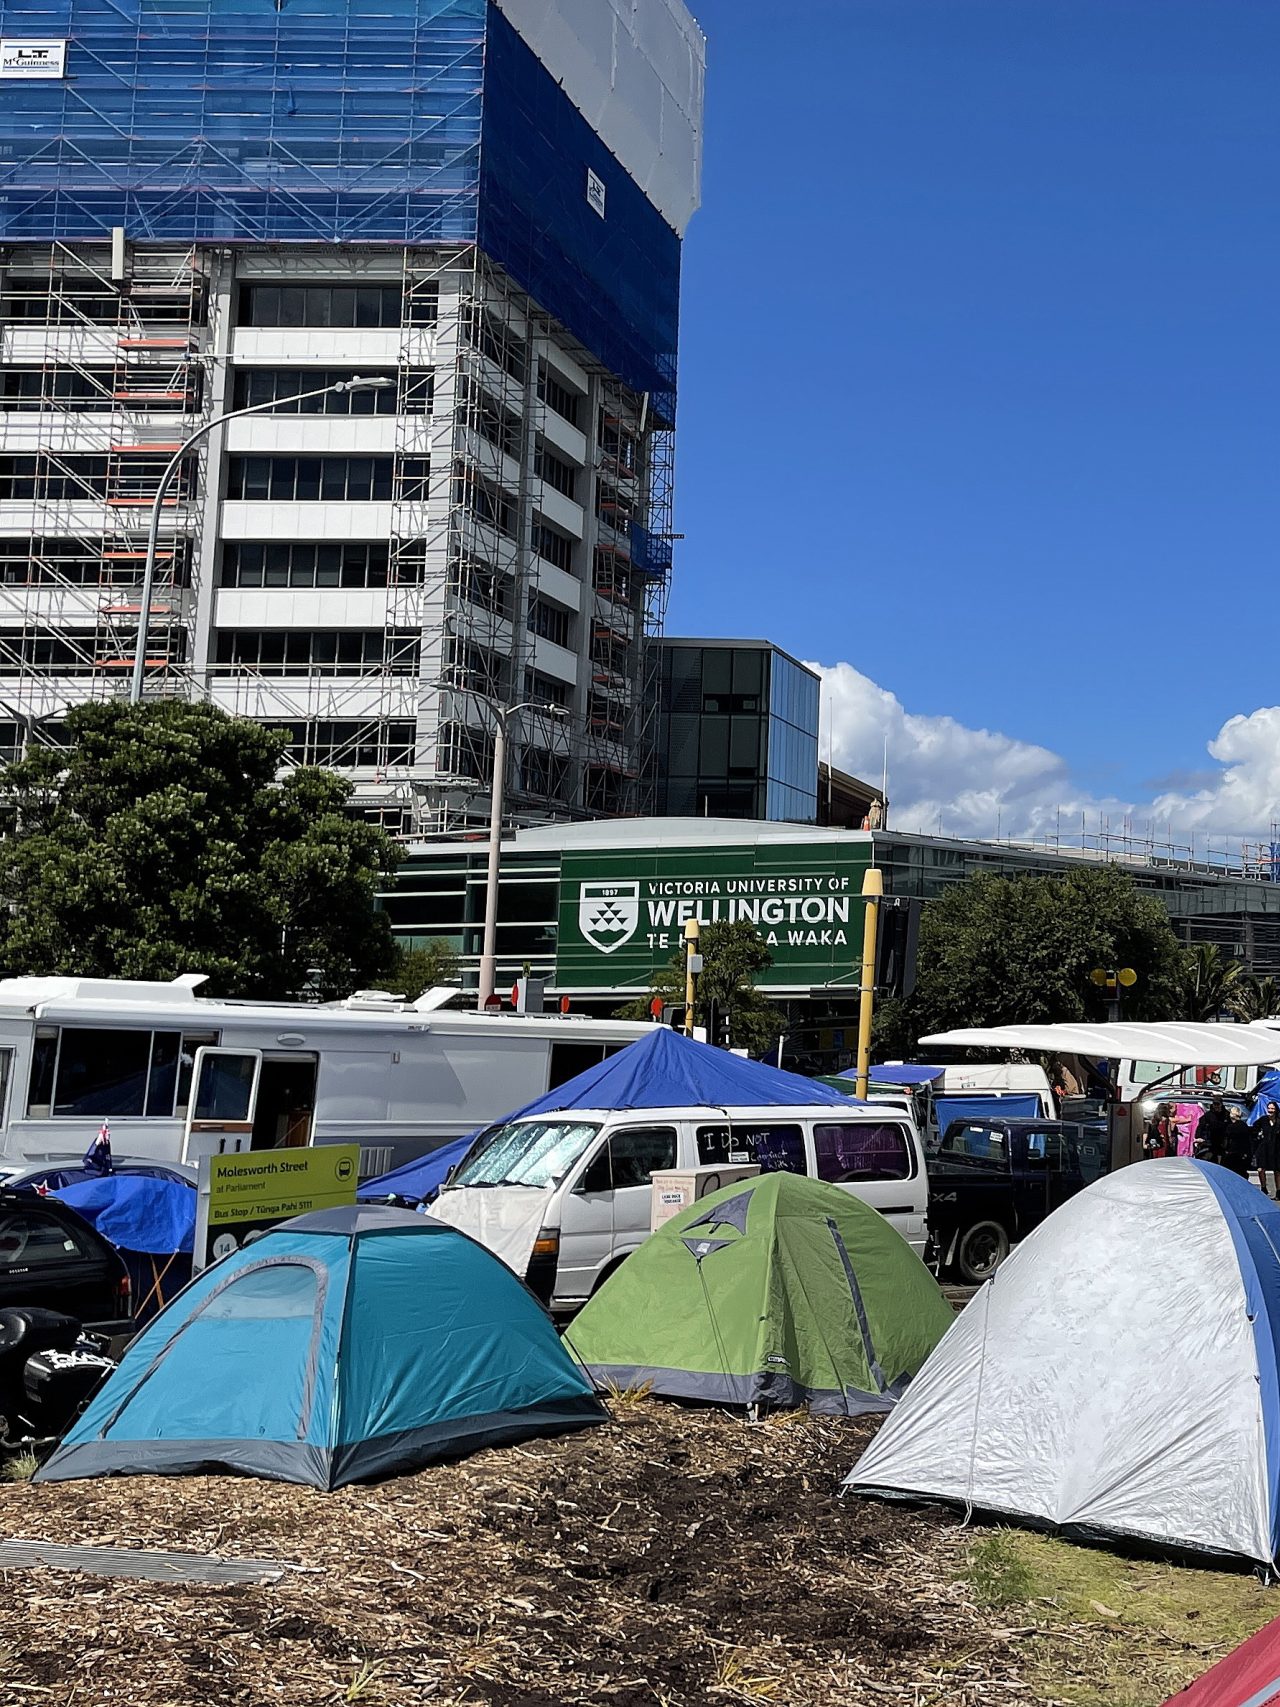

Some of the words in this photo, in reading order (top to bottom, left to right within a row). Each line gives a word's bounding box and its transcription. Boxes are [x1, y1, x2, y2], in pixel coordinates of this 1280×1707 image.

[648, 881, 721, 895] VICTORIA
[726, 878, 823, 893] UNIVERSITY
[828, 877, 850, 891] OF
[646, 933, 669, 949] TE
[787, 929, 848, 946] WAKA
[745, 1132, 770, 1146] NOT
[217, 1163, 278, 1178] Molesworth
[280, 1160, 308, 1173] Street
[216, 1185, 224, 1193] at
[226, 1181, 266, 1192] Parliament
[214, 1210, 229, 1218] Bus
[230, 1208, 249, 1217] Stop
[220, 1243, 231, 1254] 14
